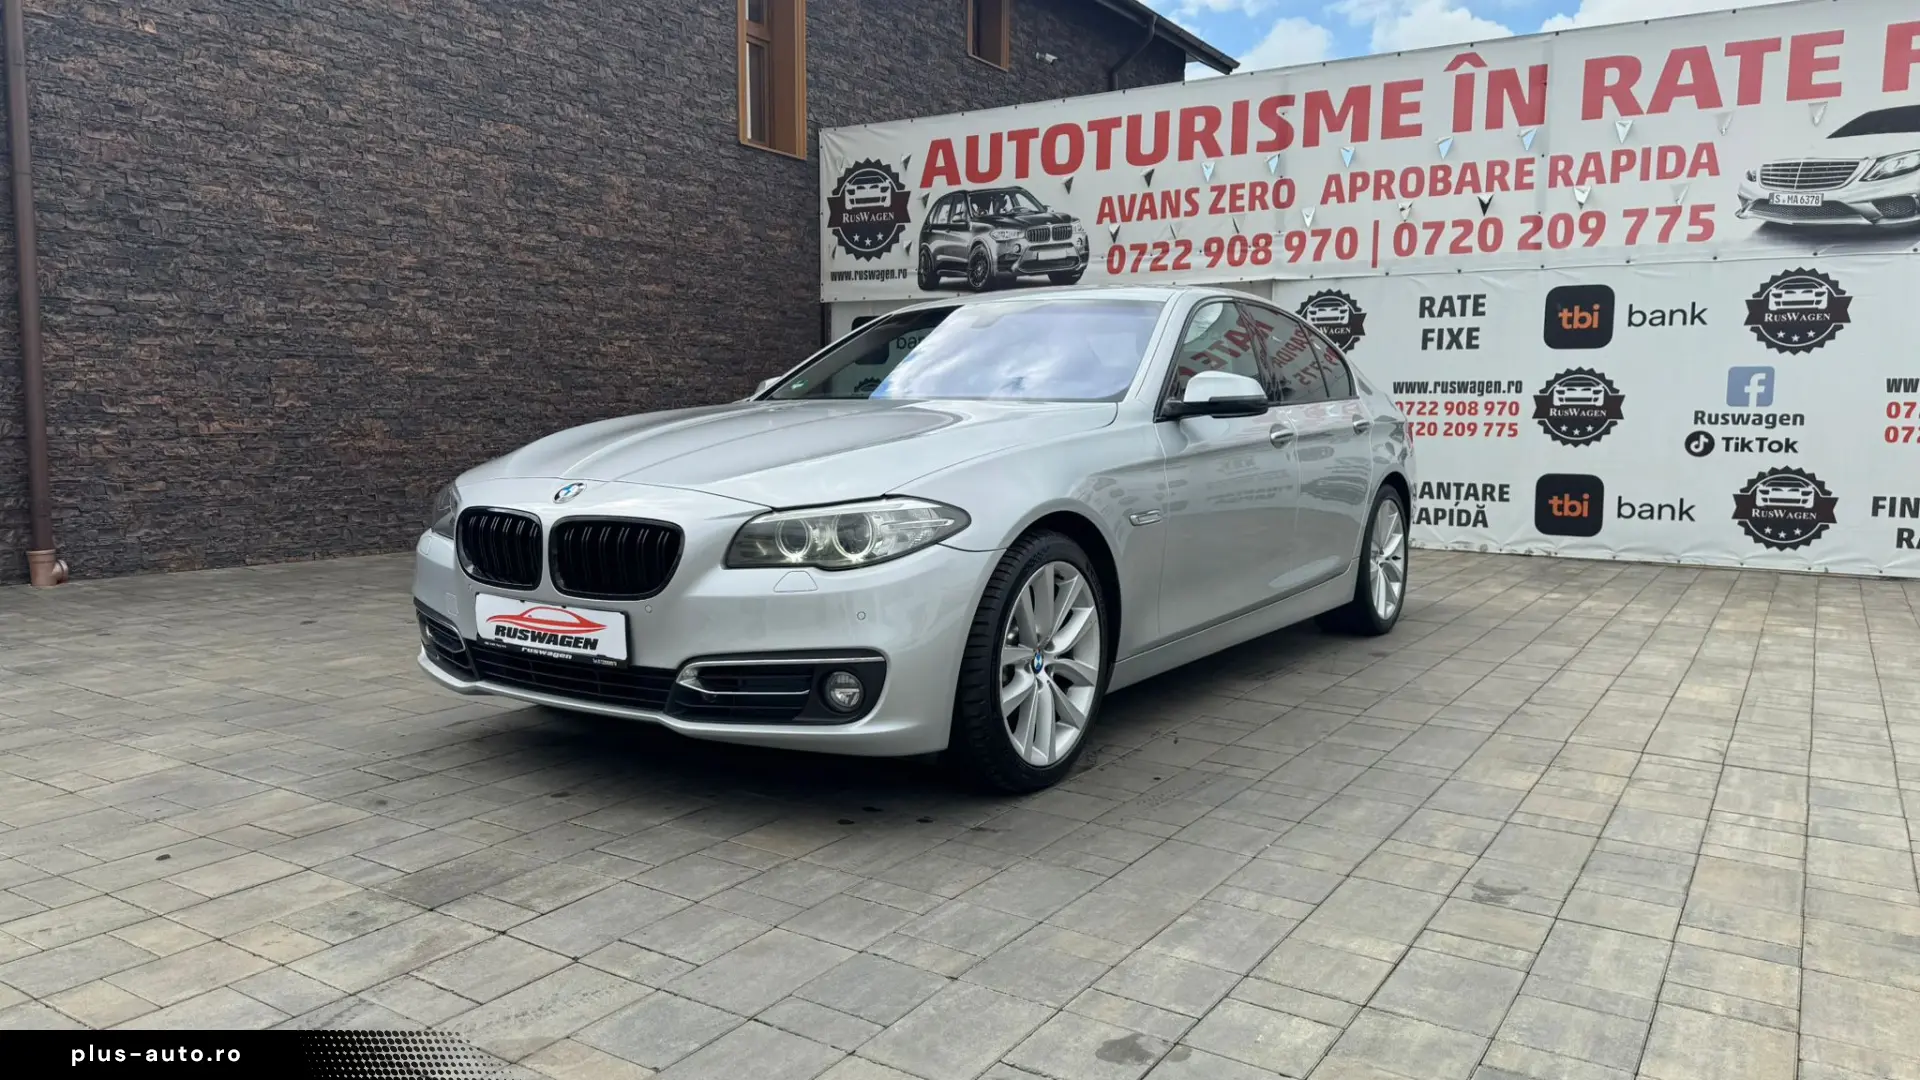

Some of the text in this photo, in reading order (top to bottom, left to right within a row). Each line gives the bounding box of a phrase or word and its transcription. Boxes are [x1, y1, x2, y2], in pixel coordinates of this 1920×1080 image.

[920, 79, 1424, 189] AUTOTURISME
[1444, 52, 1548, 133] ÎN
[1581, 30, 1844, 121] RATE
[1096, 142, 1720, 225] AVANS ZERO APROBARE RAPIDA
[1106, 239, 1193, 275] 0722
[1203, 233, 1273, 268] 908
[1284, 227, 1359, 264] 970
[1393, 217, 1504, 257] 0720
[1517, 210, 1606, 251] 209
[1622, 204, 1715, 246] 775
[829, 267, 908, 283] www.ruswagen.ro
[1418, 293, 1487, 319] RATE
[1558, 304, 1600, 330] tbi
[1627, 301, 1709, 328] bank
[1421, 326, 1480, 351] FIXE
[1393, 380, 1523, 397] www.ruswagen.ro
[1444, 401, 1479, 416] 908
[1484, 401, 1520, 417] 970
[1693, 410, 1805, 430] Ruswagen
[1886, 401, 1920, 420] 07
[1443, 422, 1478, 437] 209
[1484, 422, 1519, 438] 775
[1884, 426, 1920, 444] 07
[1721, 436, 1799, 454] TikTok
[1549, 494, 1589, 517] tbi
[1617, 495, 1696, 522] bank
[494, 624, 599, 651] RUSWAGEN
[521, 646, 573, 660] ruswagen
